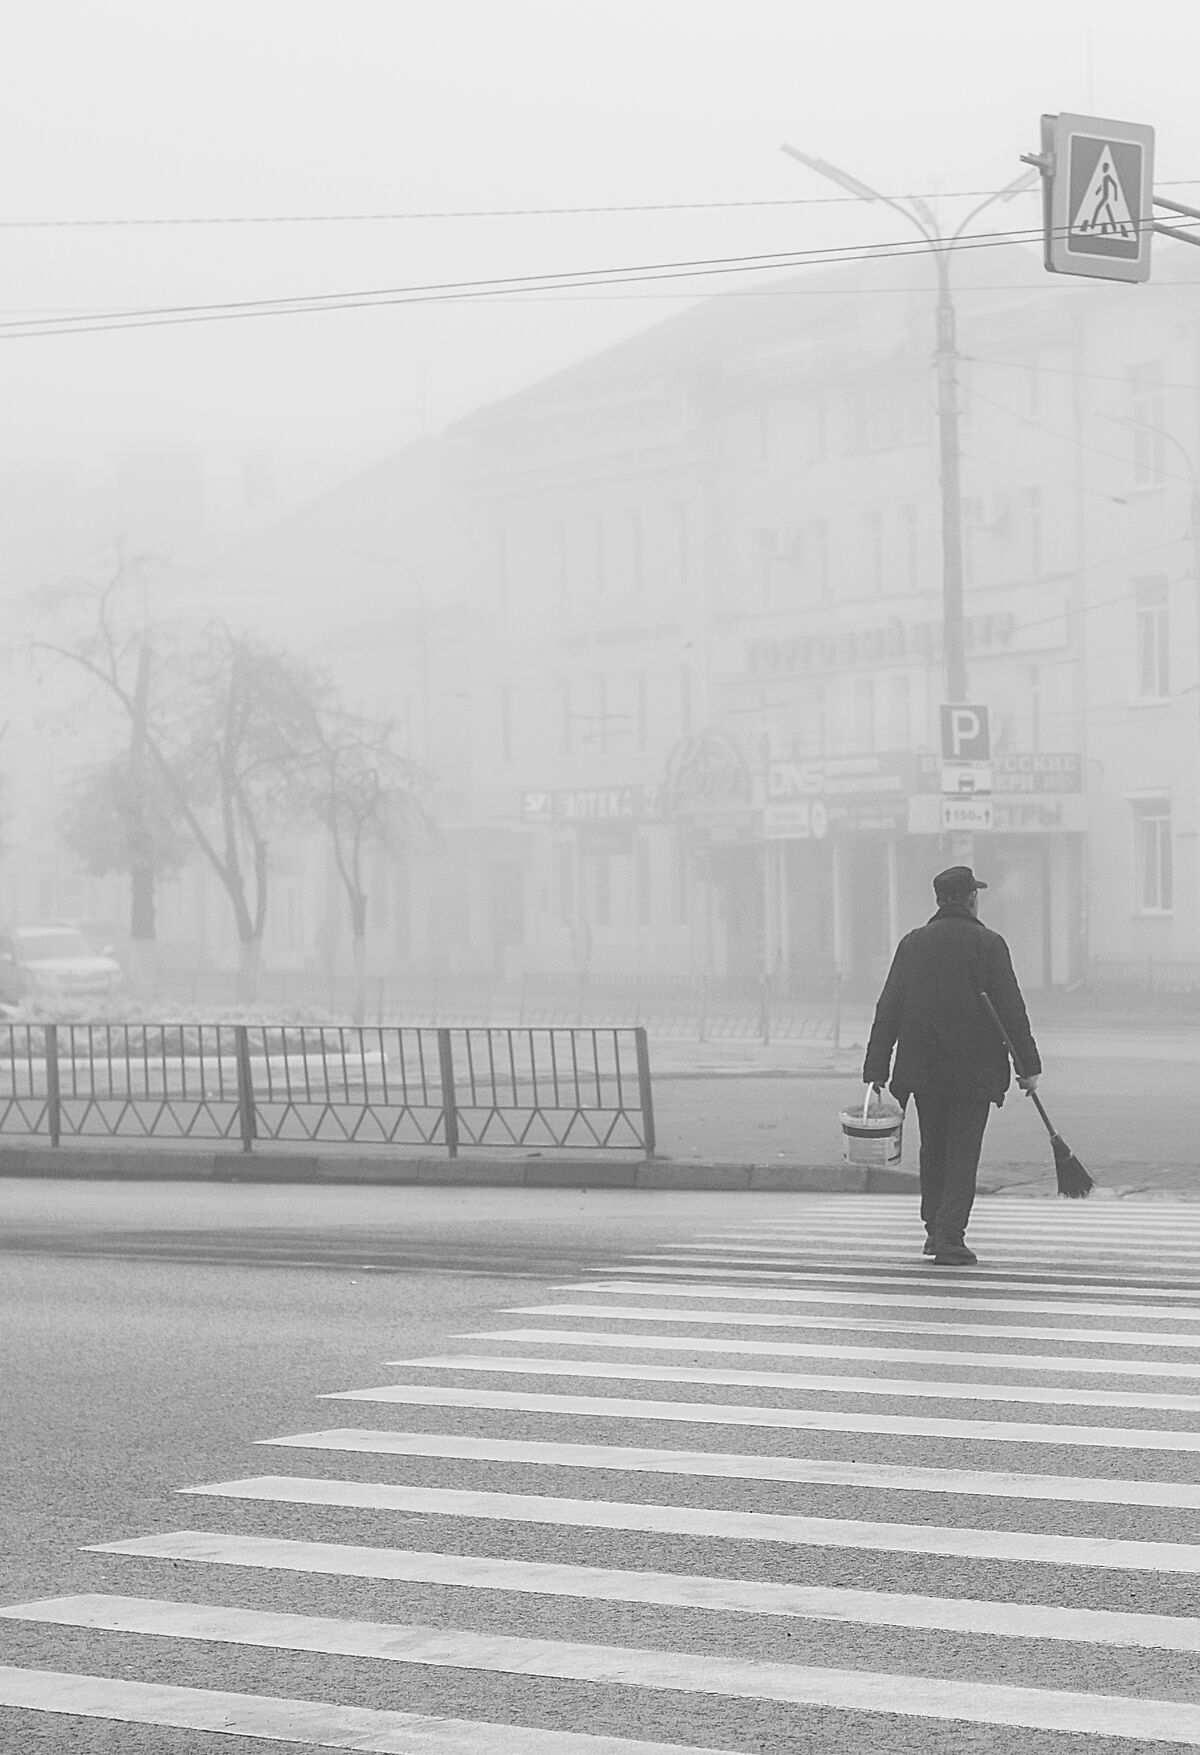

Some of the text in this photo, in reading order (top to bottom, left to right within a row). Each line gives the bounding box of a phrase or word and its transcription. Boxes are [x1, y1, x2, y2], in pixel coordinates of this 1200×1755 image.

[911, 611, 1016, 660] ЦТР
[952, 710, 980, 755] P
[768, 762, 824, 797] DNS
